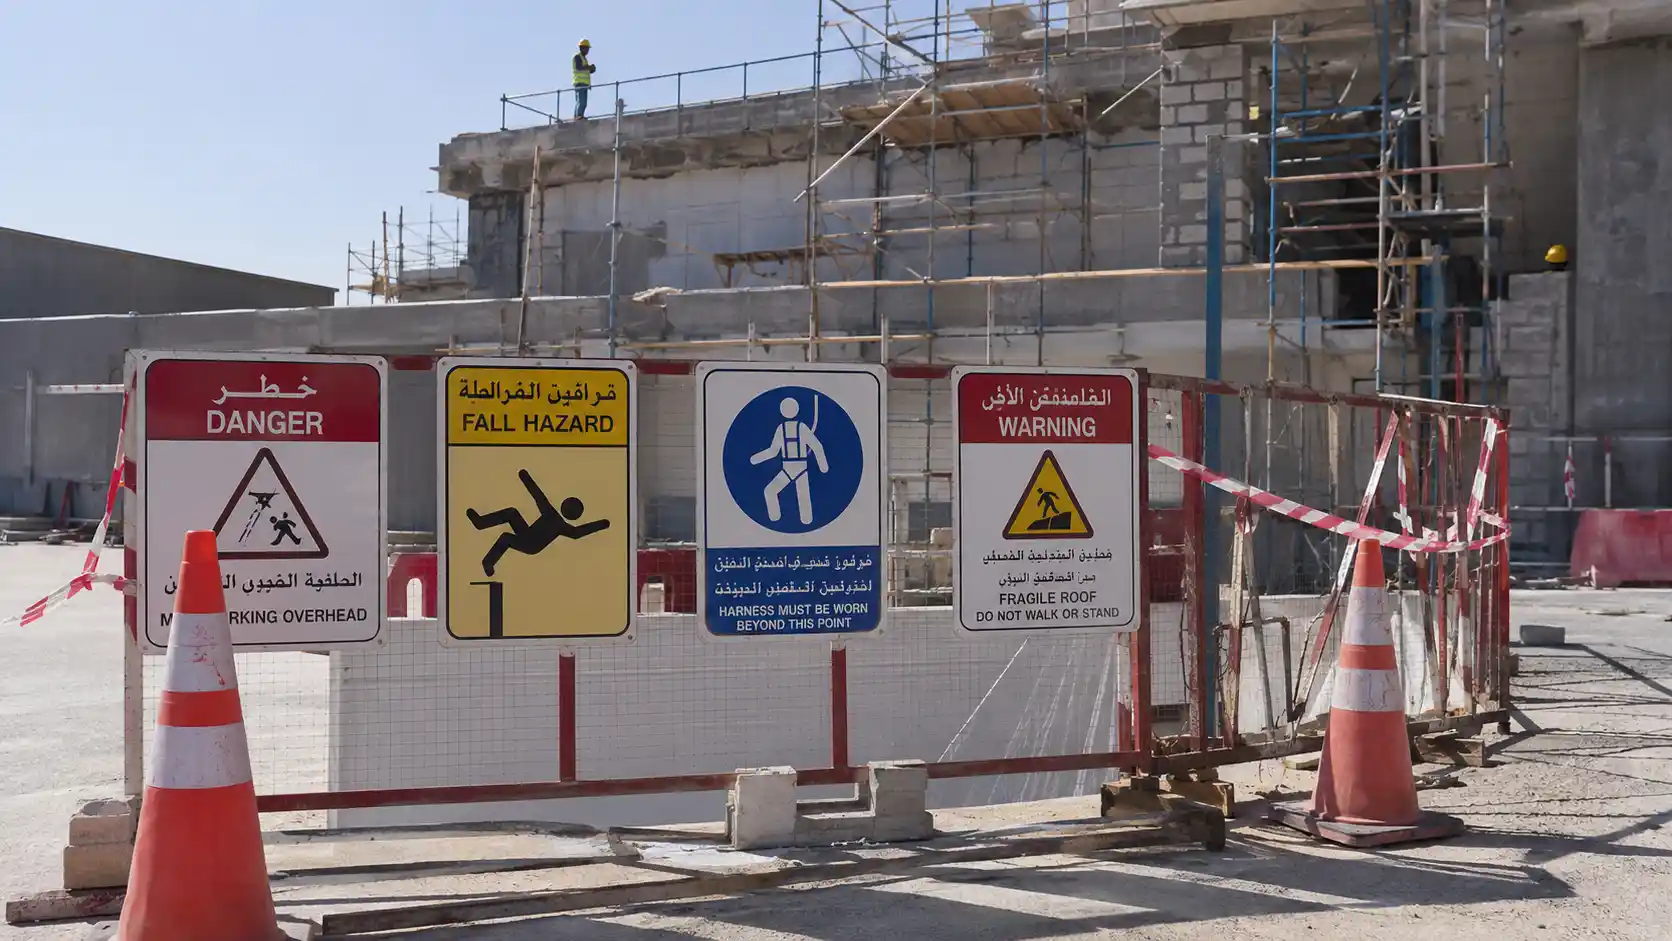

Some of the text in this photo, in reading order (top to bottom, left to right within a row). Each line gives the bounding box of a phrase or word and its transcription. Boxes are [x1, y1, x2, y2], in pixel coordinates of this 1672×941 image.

[211, 373, 318, 406] خطر
[206, 409, 323, 435] DANGER
[462, 413, 614, 433] FALL HAZARD
[998, 416, 1096, 437] WARNING
[999, 591, 1097, 606] FRAGILE ROOF
[229, 608, 367, 625] RKING OVERHEAD
[719, 602, 868, 617] HARNESS MUST BE WORN
[976, 608, 1120, 622] DO NOT WALK OR STAND
[736, 617, 852, 632] BEYOND THIS POINT
